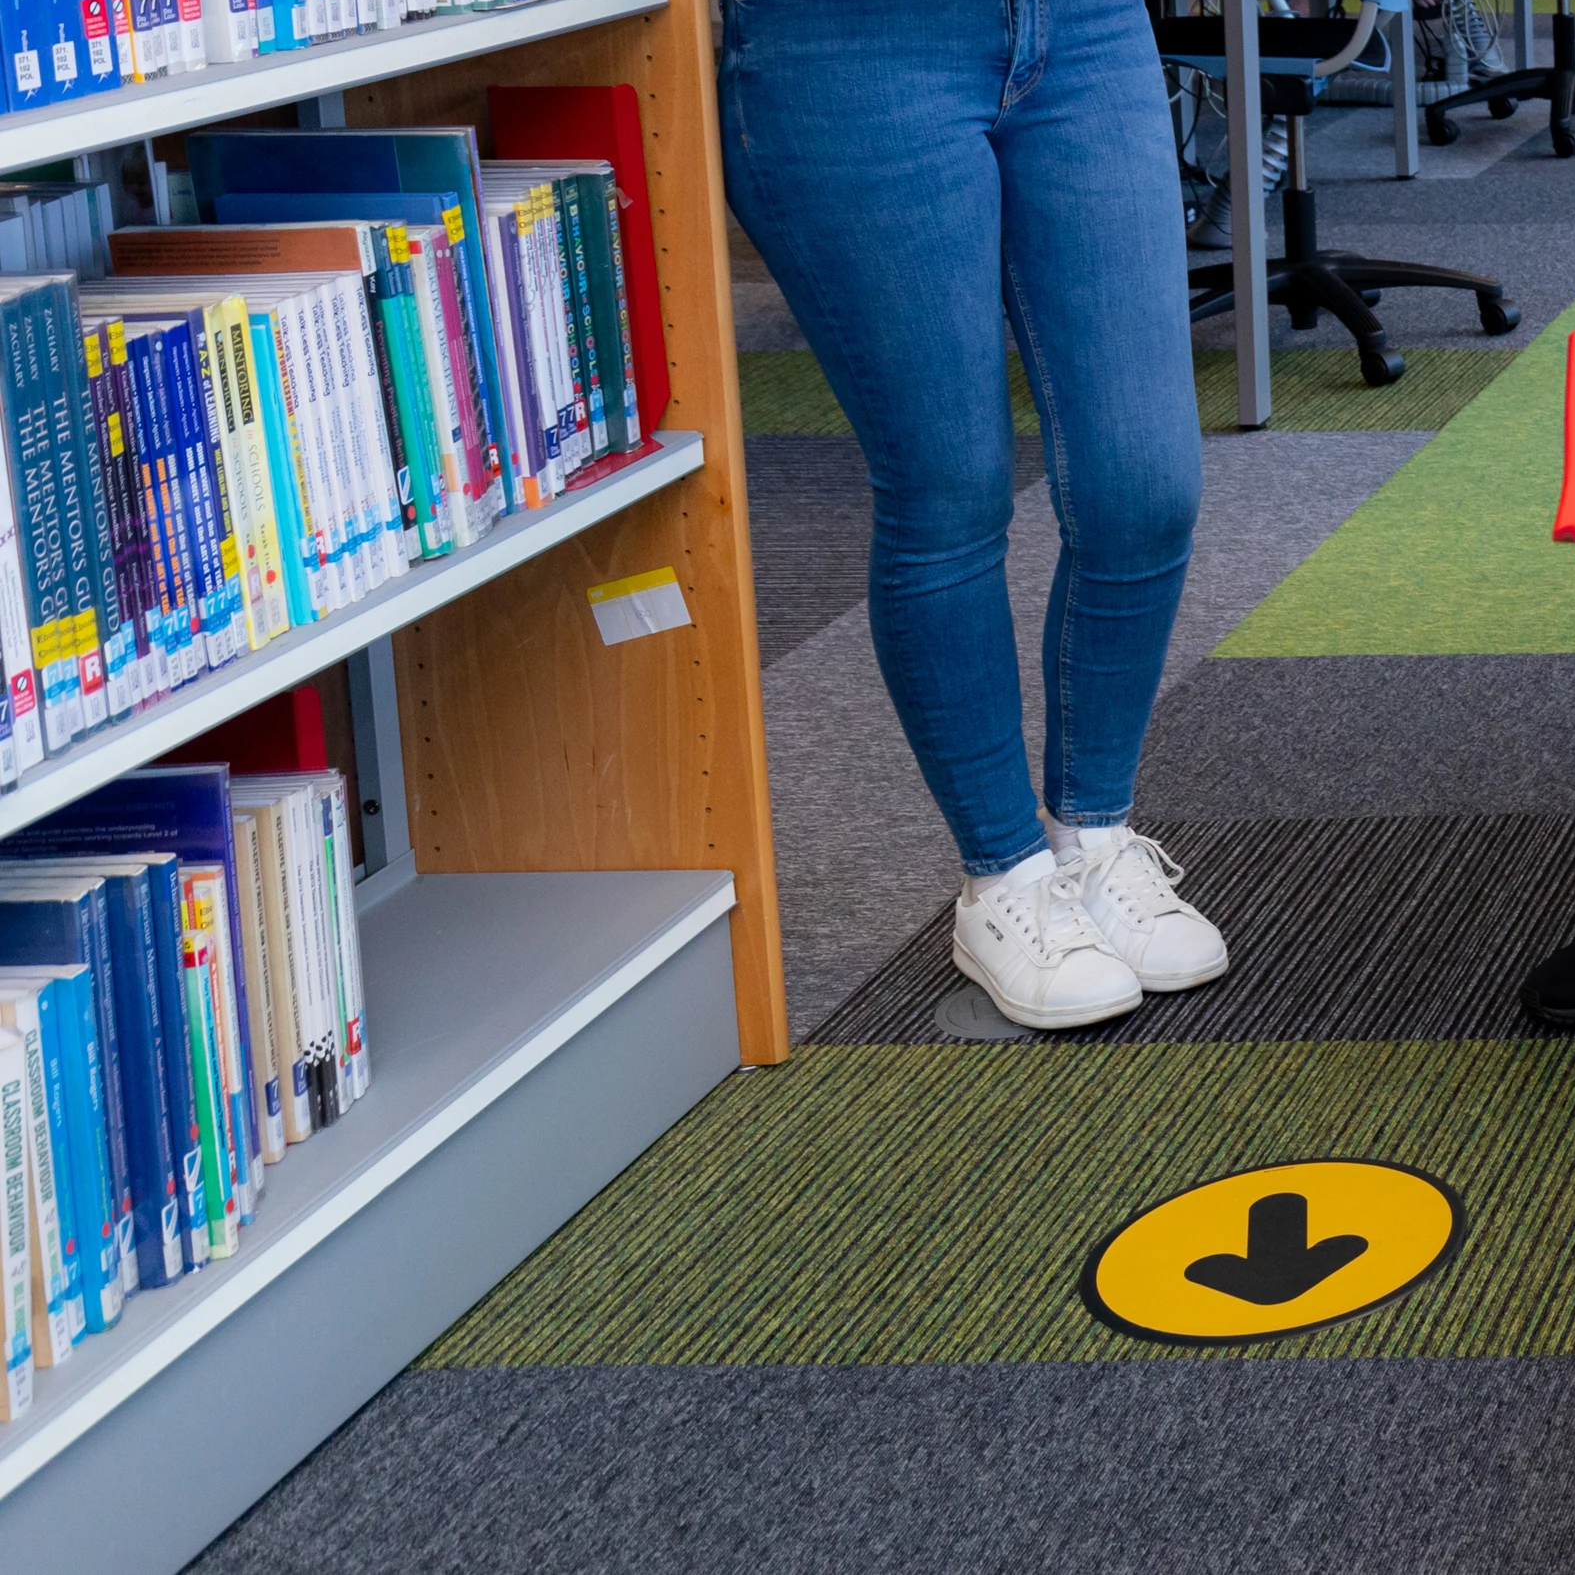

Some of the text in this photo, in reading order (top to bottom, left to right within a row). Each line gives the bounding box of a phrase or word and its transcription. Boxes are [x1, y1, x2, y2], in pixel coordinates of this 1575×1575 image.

[570, 204, 587, 293] BEHAVIOUR
[608, 199, 623, 288] BEHAVIOUR
[9, 323, 25, 389] ZACHARY
[44, 308, 59, 372] ZACHARY
[275, 330, 283, 351] PIMP
[279, 353, 287, 377] YOUR
[298, 311, 317, 402] Talk-Less Teaching
[423, 238, 459, 424] ASSERTIVE DISCIPLINE
[122, 370, 132, 409] Teacher's
[199, 350, 220, 443] A-Z of LEARNING
[231, 331, 254, 423] MENTORING
[248, 444, 266, 512] SCHOOLS
[126, 411, 136, 453] Reflective
[196, 442, 204, 465] JOHN
[18, 407, 51, 591] THE MENTOR'S
[53, 391, 87, 571] THE MENTOR'S
[138, 491, 148, 539] Handbook
[200, 466, 210, 497] DEWEY
[204, 499, 212, 514] and
[207, 517, 215, 535] the
[210, 537, 218, 554] ART
[140, 883, 159, 1027] Behaviour Management
[169, 871, 188, 1014] Behaviour Management
[1, 1079, 23, 1174] CLASSROOM
[25, 1029, 53, 1205] CLASSROOM BEHAVIOUR
[53, 1080, 62, 1127] Rogers
[6, 1176, 26, 1258] BEHAVIOUR
